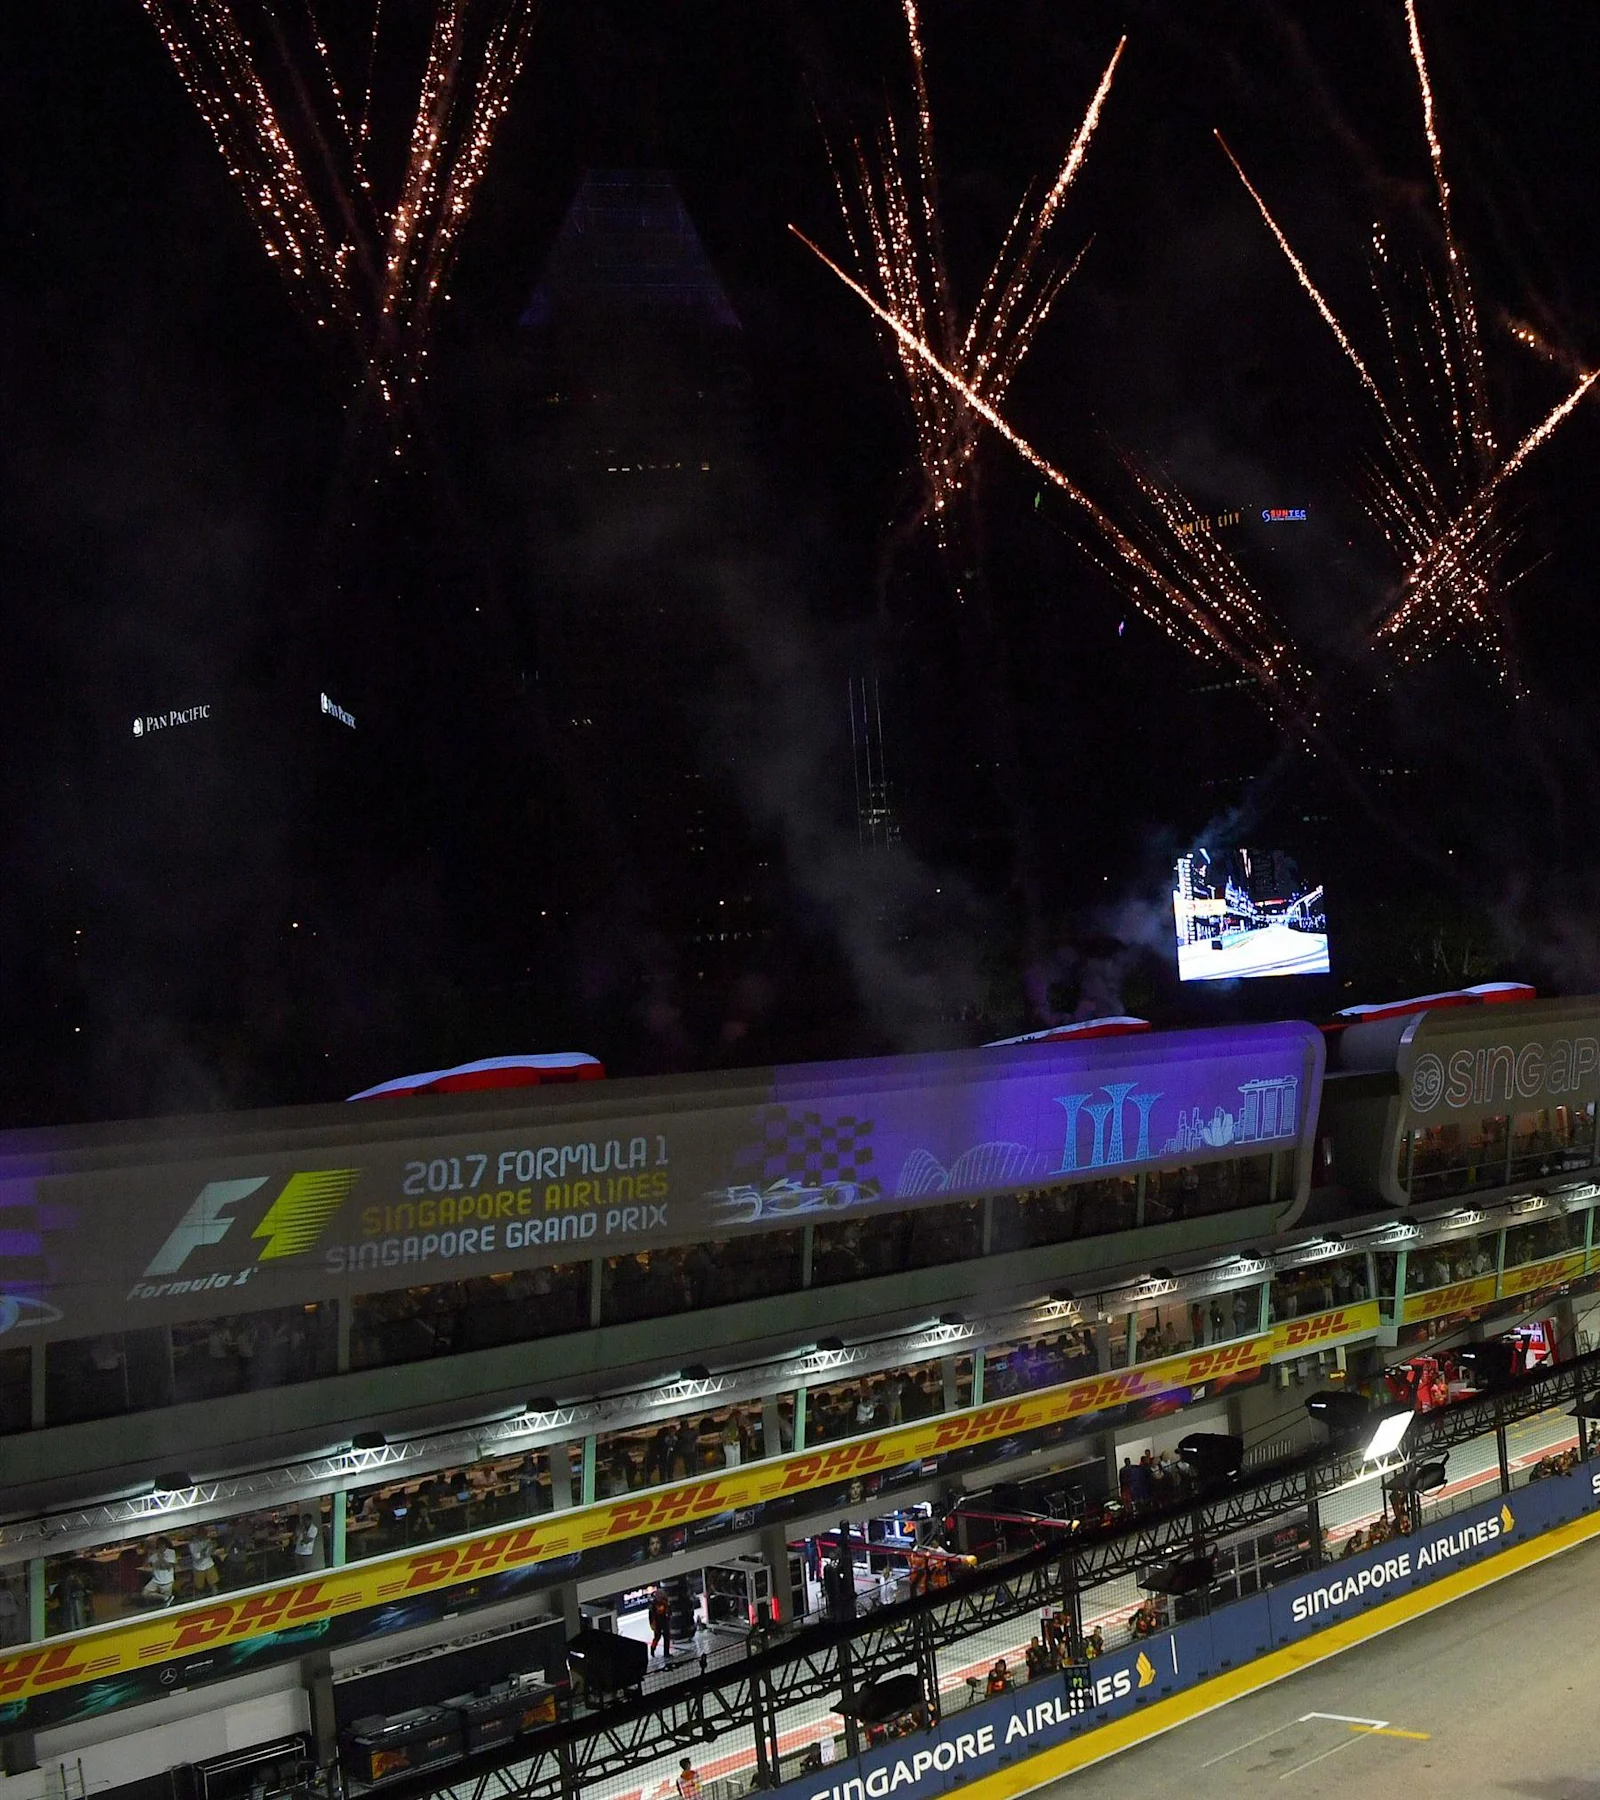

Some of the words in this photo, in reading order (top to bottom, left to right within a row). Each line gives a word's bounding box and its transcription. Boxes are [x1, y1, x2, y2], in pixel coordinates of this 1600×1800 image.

[146, 714, 168, 732] PAN
[169, 704, 211, 727] PACIFIC
[402, 1153, 489, 1195] 2017
[497, 1137, 647, 1185] FORMULA
[655, 1135, 669, 1166] 1
[360, 1187, 533, 1235] SINGAPORE
[544, 1172, 669, 1212] AIRLINES
[324, 1225, 496, 1274] SINGAPORE
[505, 1211, 598, 1249] GRAND
[605, 1202, 669, 1236] PRIX
[127, 1271, 231, 1300] Formula
[1422, 1285, 1477, 1315] DHL
[1285, 1312, 1351, 1347] DHL
[1186, 1343, 1259, 1380] DHL
[1066, 1371, 1148, 1413] DHL
[933, 1402, 1026, 1449] DHL
[780, 1440, 886, 1490] DHL
[606, 1482, 728, 1535] DHL
[403, 1529, 542, 1589] DHL
[1292, 1553, 1411, 1623] SINGAPORE
[1416, 1516, 1500, 1570] AIRLINES
[169, 1582, 334, 1651] DHL
[0, 1645, 86, 1694] HL
